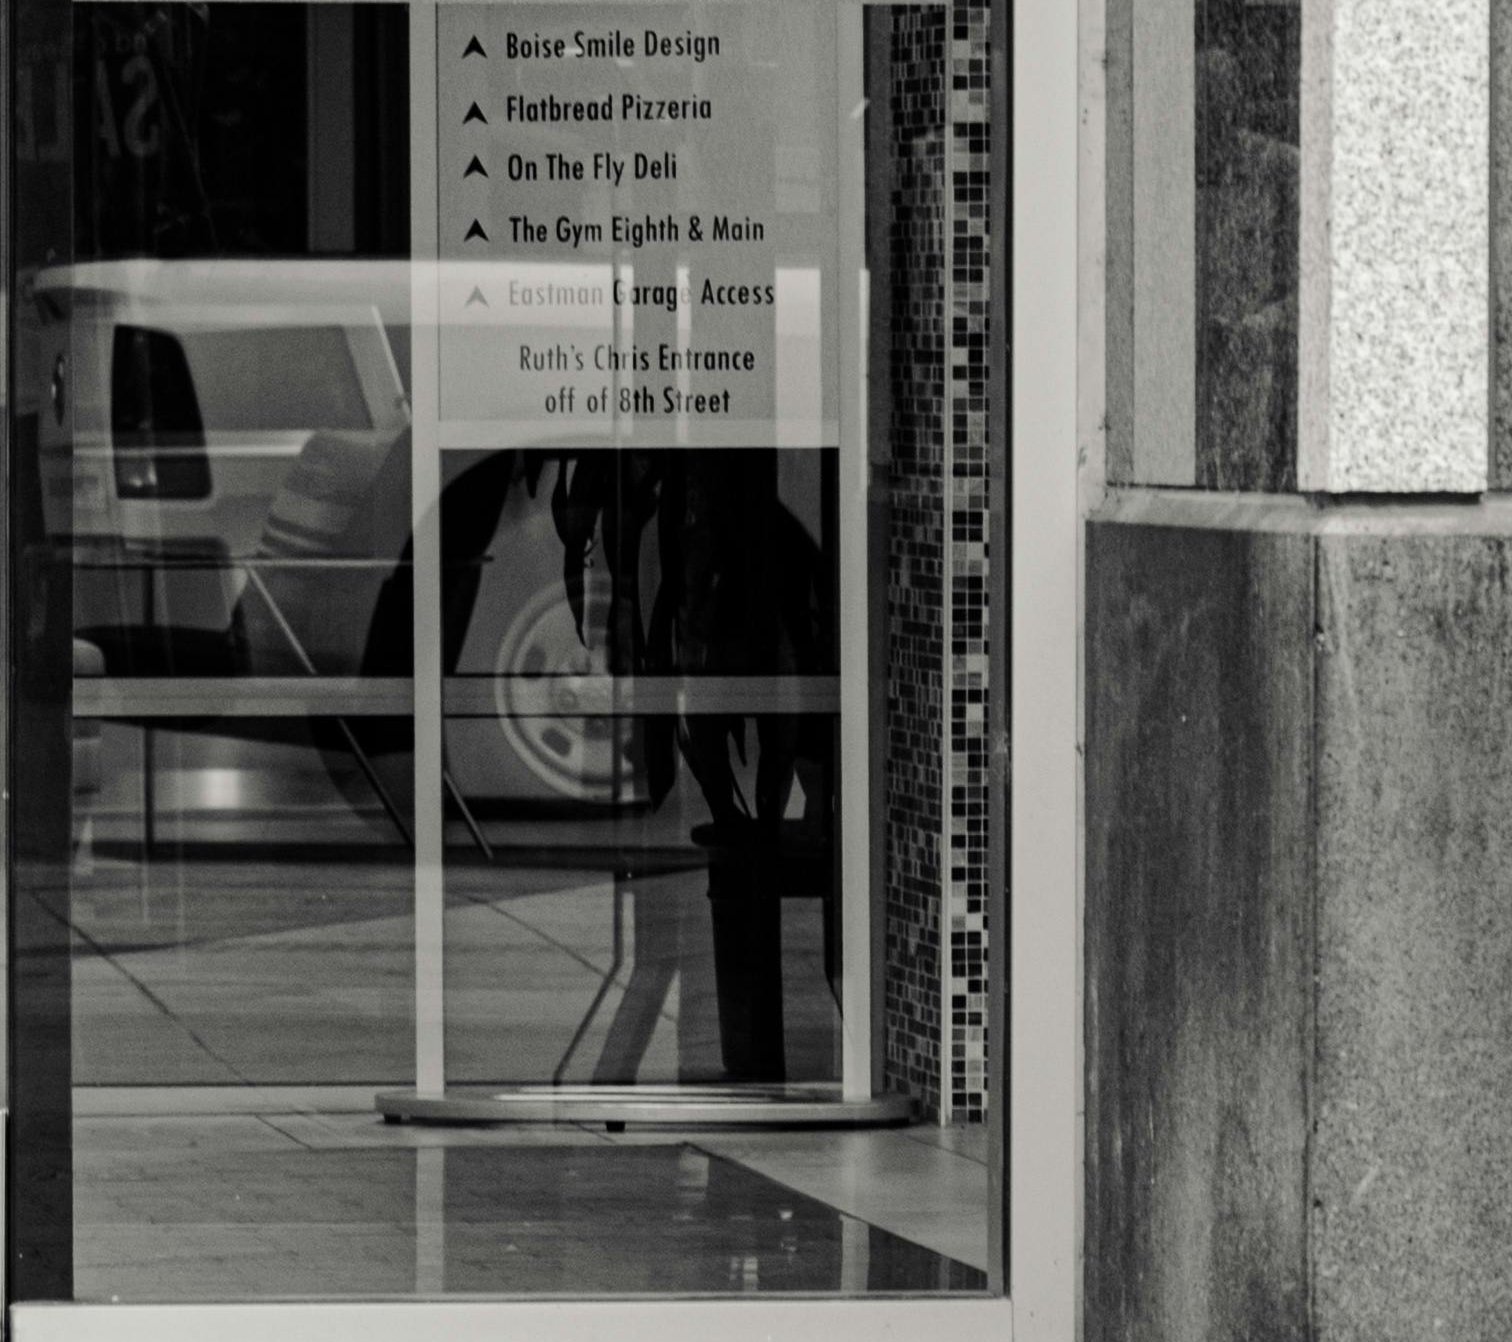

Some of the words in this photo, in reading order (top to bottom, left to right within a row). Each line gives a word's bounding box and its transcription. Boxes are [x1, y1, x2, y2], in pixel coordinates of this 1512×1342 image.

[506, 32, 566, 59] Boise
[573, 30, 635, 58] Smile
[644, 30, 720, 62] Design
[506, 94, 613, 122] Flatbread
[622, 94, 712, 120] Pizzeria
[507, 154, 538, 181] On
[545, 153, 584, 180] The
[593, 152, 625, 187] Fly
[634, 151, 677, 179] Deli
[509, 215, 548, 242] The
[555, 216, 602, 248] Gym
[611, 214, 679, 248] Eighth
[687, 215, 704, 242] &
[712, 215, 765, 241] Main
[509, 280, 603, 307] Eastman
[613, 279, 691, 312] Garage
[700, 278, 775, 306] Access
[519, 344, 584, 371] Ruth's
[594, 344, 650, 371] Chris
[658, 343, 755, 371] Entrance
[544, 387, 576, 414] off
[587, 387, 609, 414] of
[619, 386, 655, 414] 8th
[663, 386, 731, 414] Street
